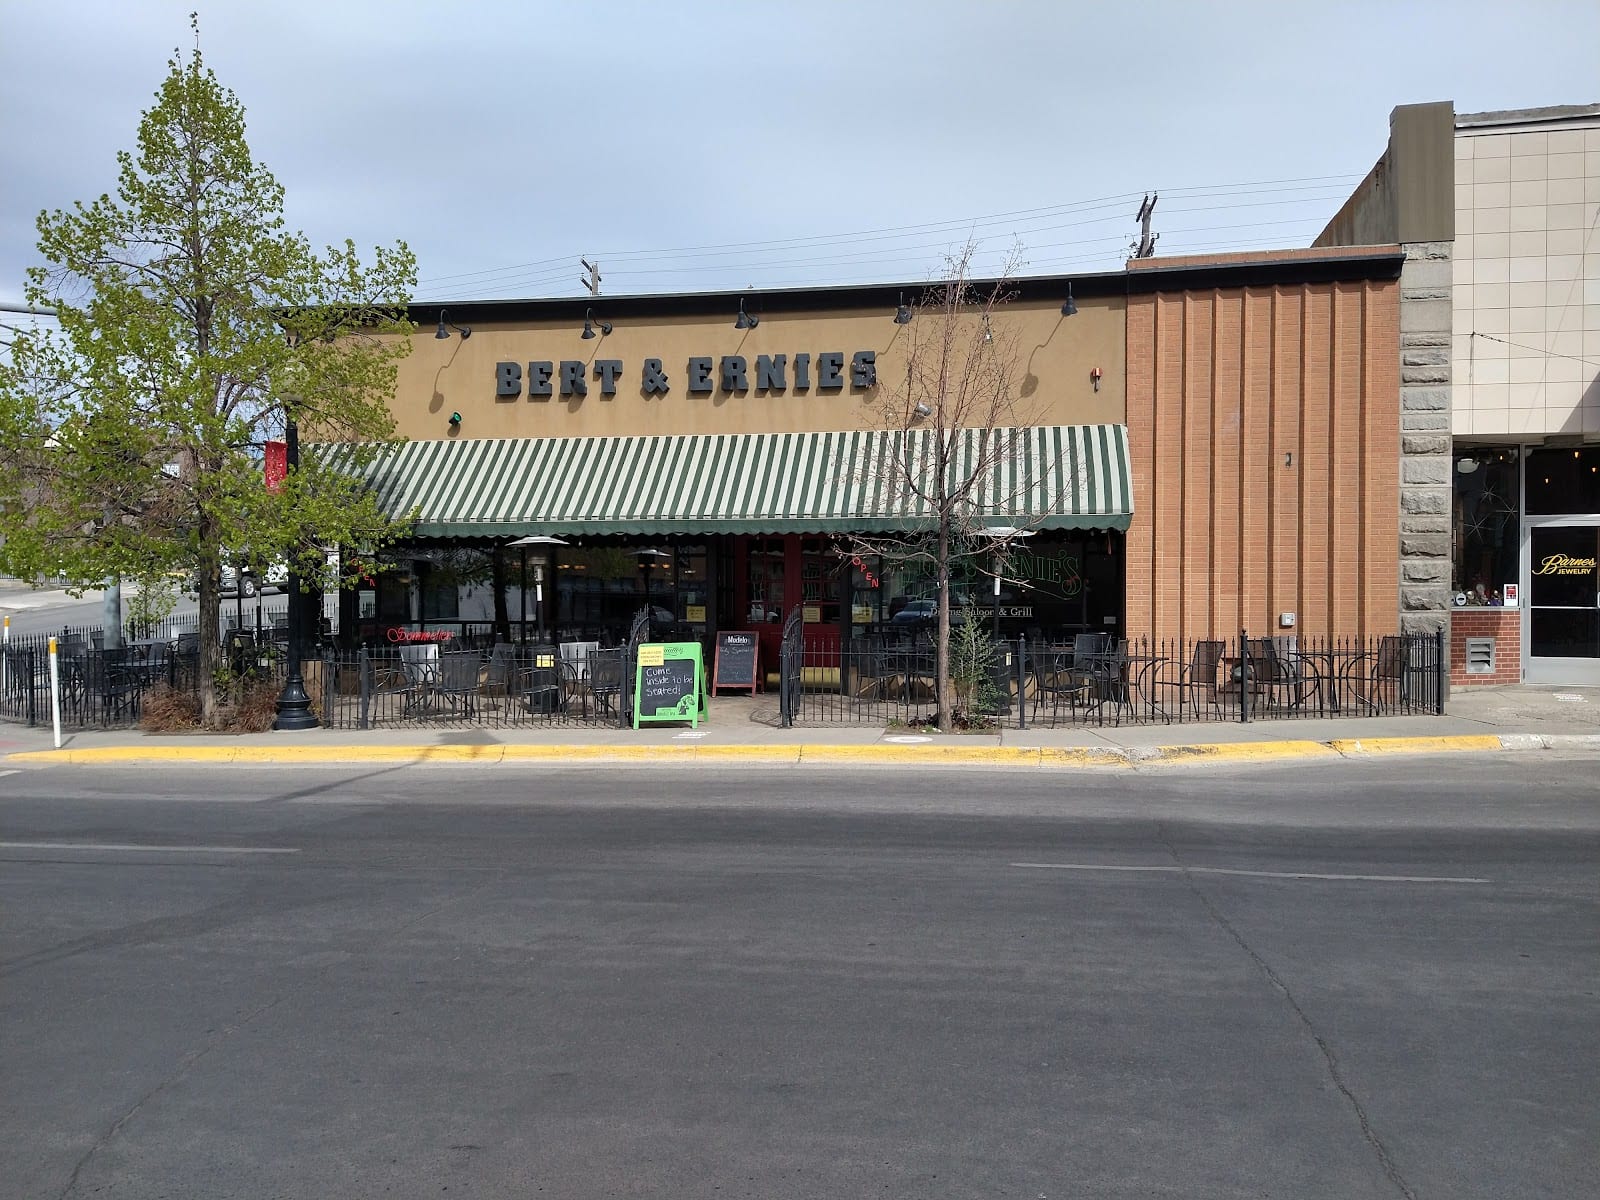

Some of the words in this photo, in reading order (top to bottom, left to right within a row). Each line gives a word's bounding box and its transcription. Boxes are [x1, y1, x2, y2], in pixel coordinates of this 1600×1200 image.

[495, 359, 623, 395] BERT
[641, 358, 670, 393] &
[688, 350, 877, 392] ERNIES
[1532, 553, 1597, 574] Barnes
[852, 556, 879, 588] OPEN
[998, 607, 1008, 617] &
[1010, 607, 1033, 617] Grill
[727, 635, 748, 644] Modelo
[646, 668, 672, 677] Come
[646, 676, 669, 686] inside
[672, 676, 682, 684] to
[683, 675, 693, 684] be
